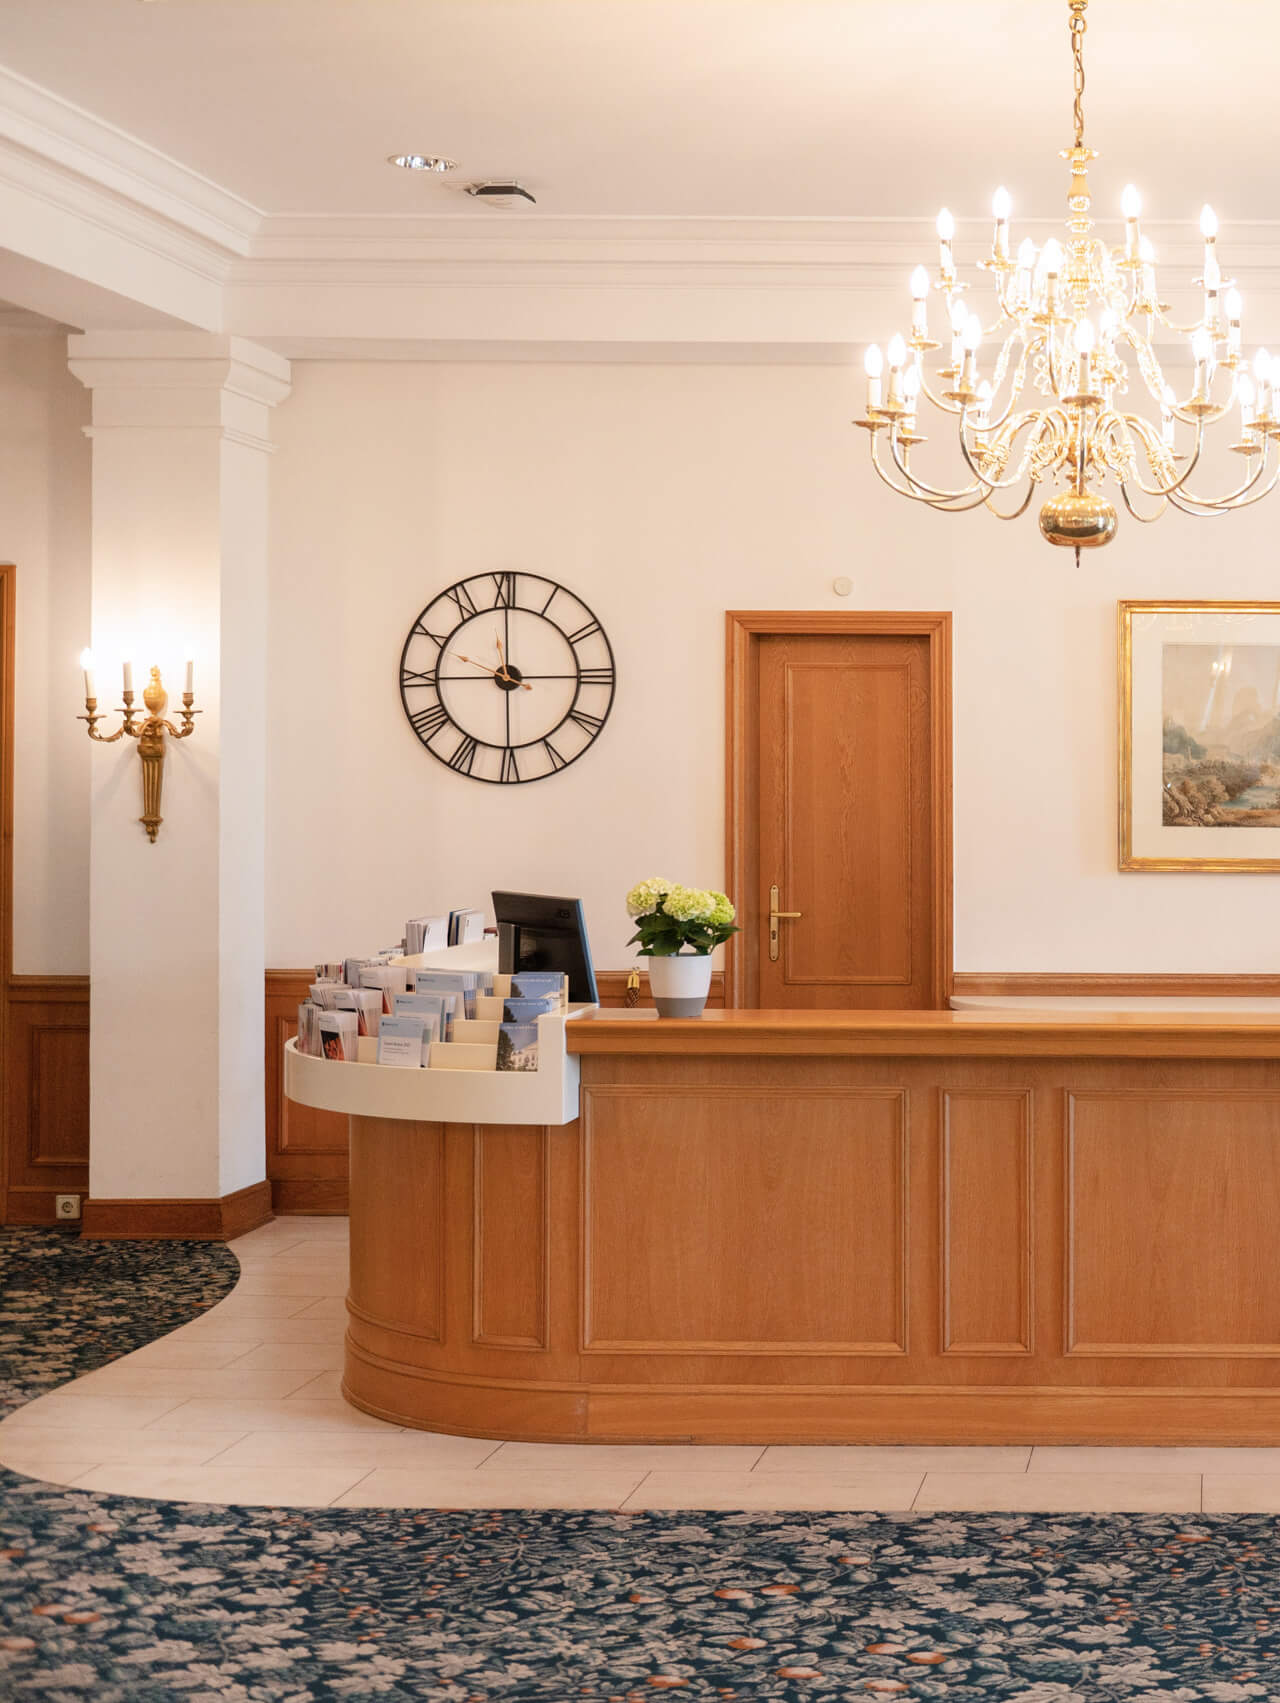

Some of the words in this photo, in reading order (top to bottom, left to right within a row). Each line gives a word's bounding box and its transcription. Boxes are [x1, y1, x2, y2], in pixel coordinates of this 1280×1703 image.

[492, 574, 516, 608] XII
[540, 586, 560, 616] I
[411, 622, 449, 650] X
[568, 620, 600, 644] II
[580, 669, 613, 684] III
[543, 739, 568, 770] V
